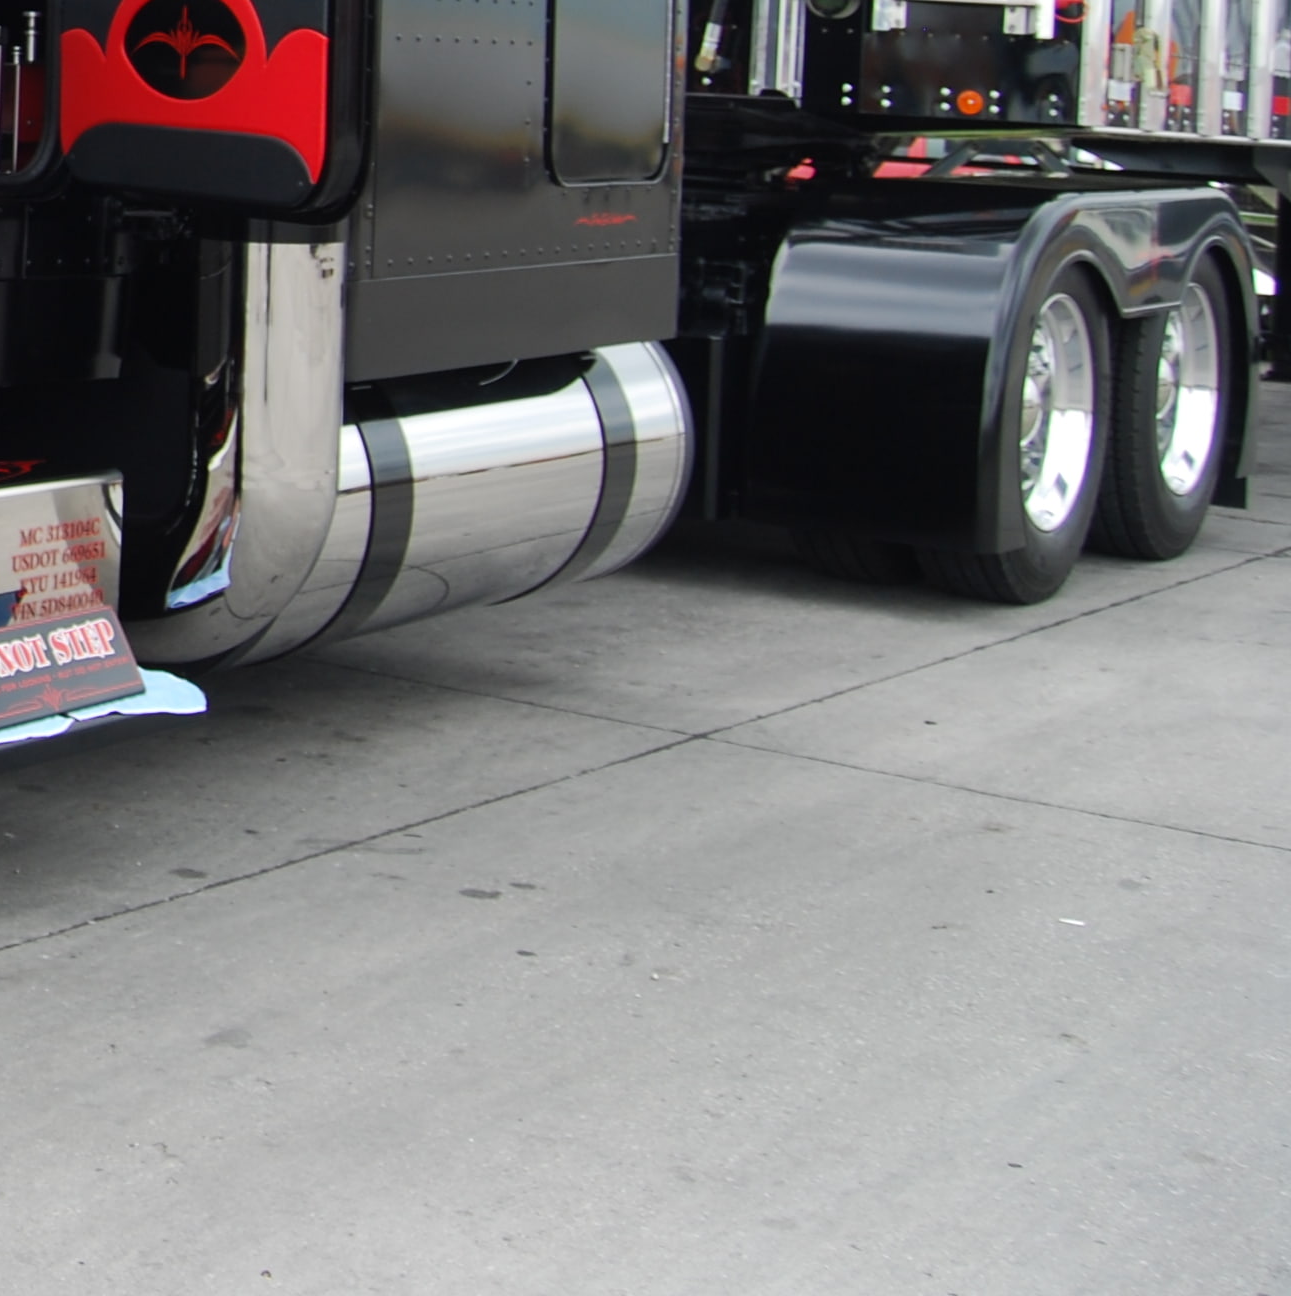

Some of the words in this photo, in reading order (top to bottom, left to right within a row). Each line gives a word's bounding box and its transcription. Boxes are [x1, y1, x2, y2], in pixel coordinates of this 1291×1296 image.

[20, 527, 43, 546] MC
[12, 549, 59, 573] USDOT
[11, 601, 37, 621] VIN
[48, 618, 115, 666] STEP
